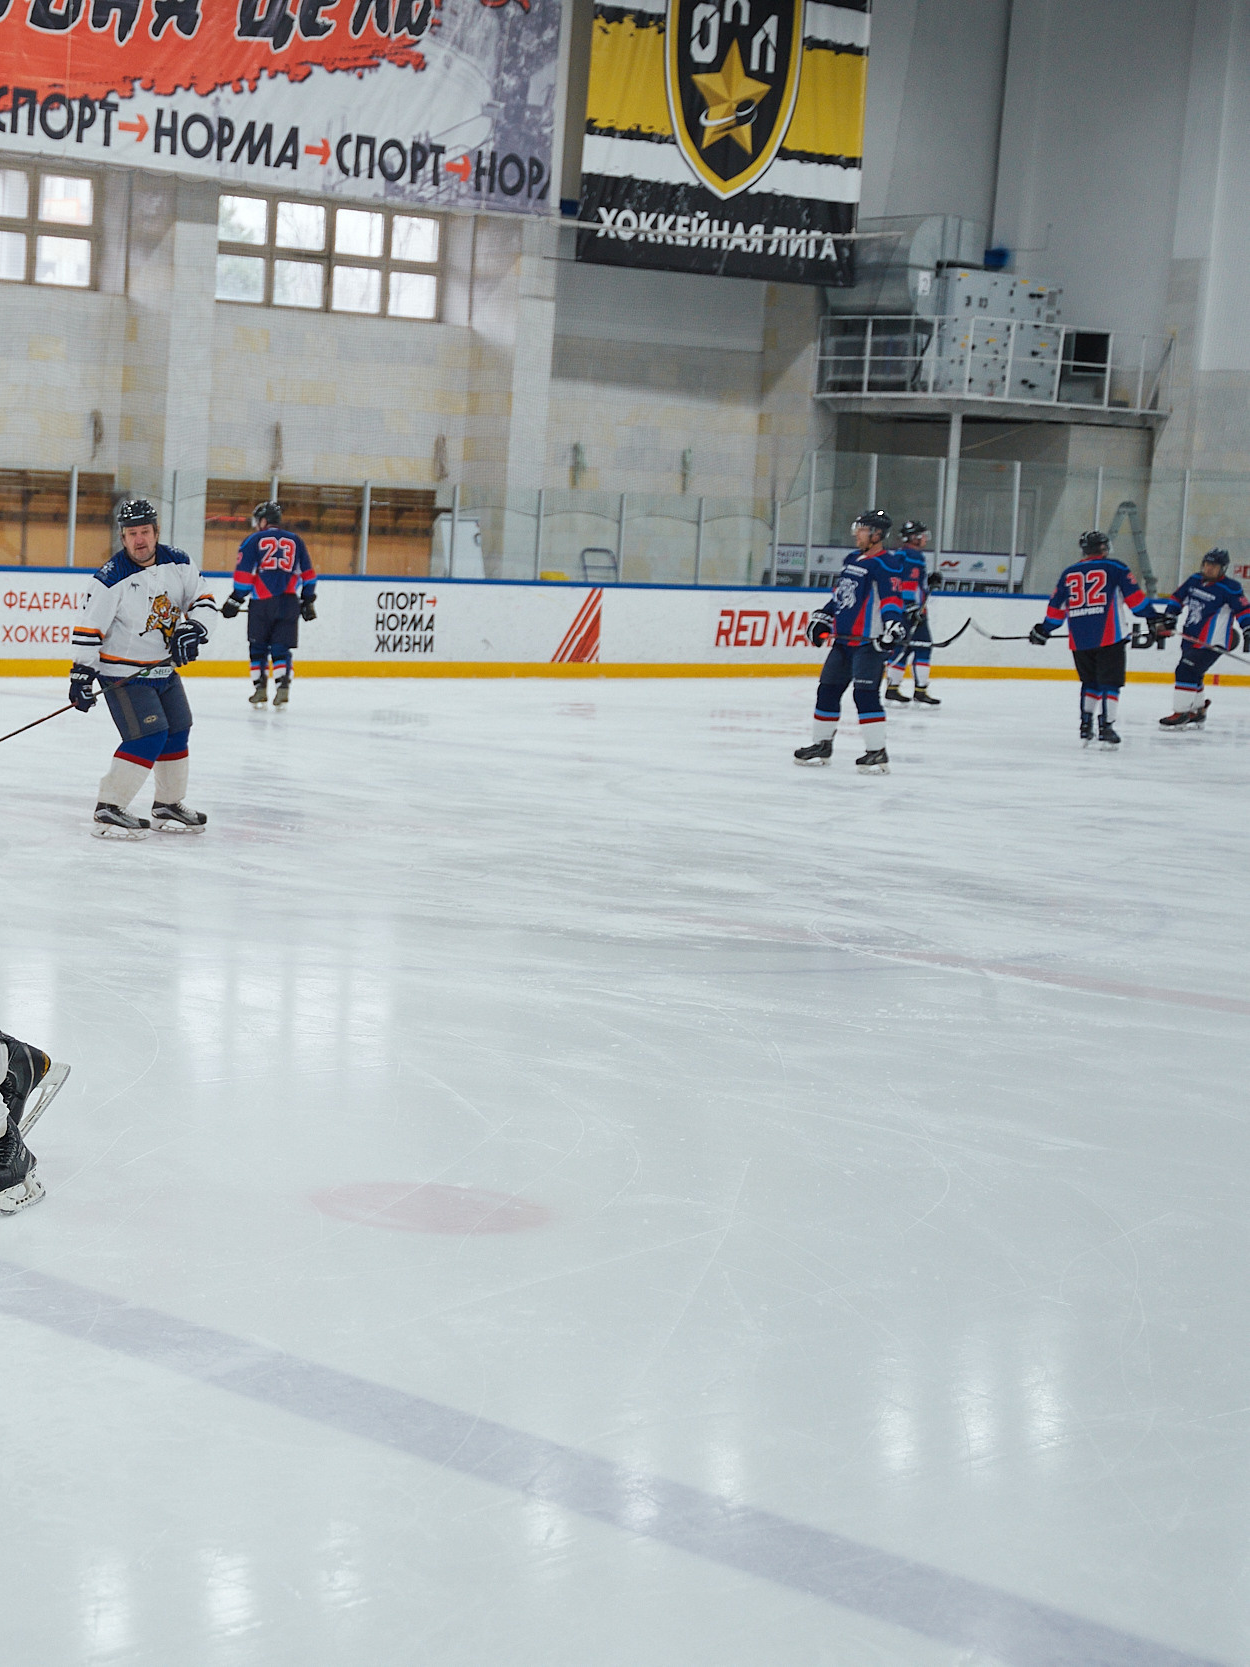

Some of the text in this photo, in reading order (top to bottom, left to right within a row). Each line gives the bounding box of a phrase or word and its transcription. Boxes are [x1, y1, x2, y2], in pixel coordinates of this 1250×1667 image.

[153, 108, 299, 170] НОРМА
[336, 133, 446, 186] СПОРТ
[596, 206, 838, 263] ХОККЕЙНАЯ ЛИГА
[258, 536, 297, 573] 23
[377, 592, 426, 610] СПОРТ
[1065, 569, 1107, 610] 32
[2, 624, 70, 643] ХОККЕЯ
[375, 613, 434, 632] НОРМА
[715, 609, 770, 647] RED
[375, 634, 434, 653] ЖИЗНИ
